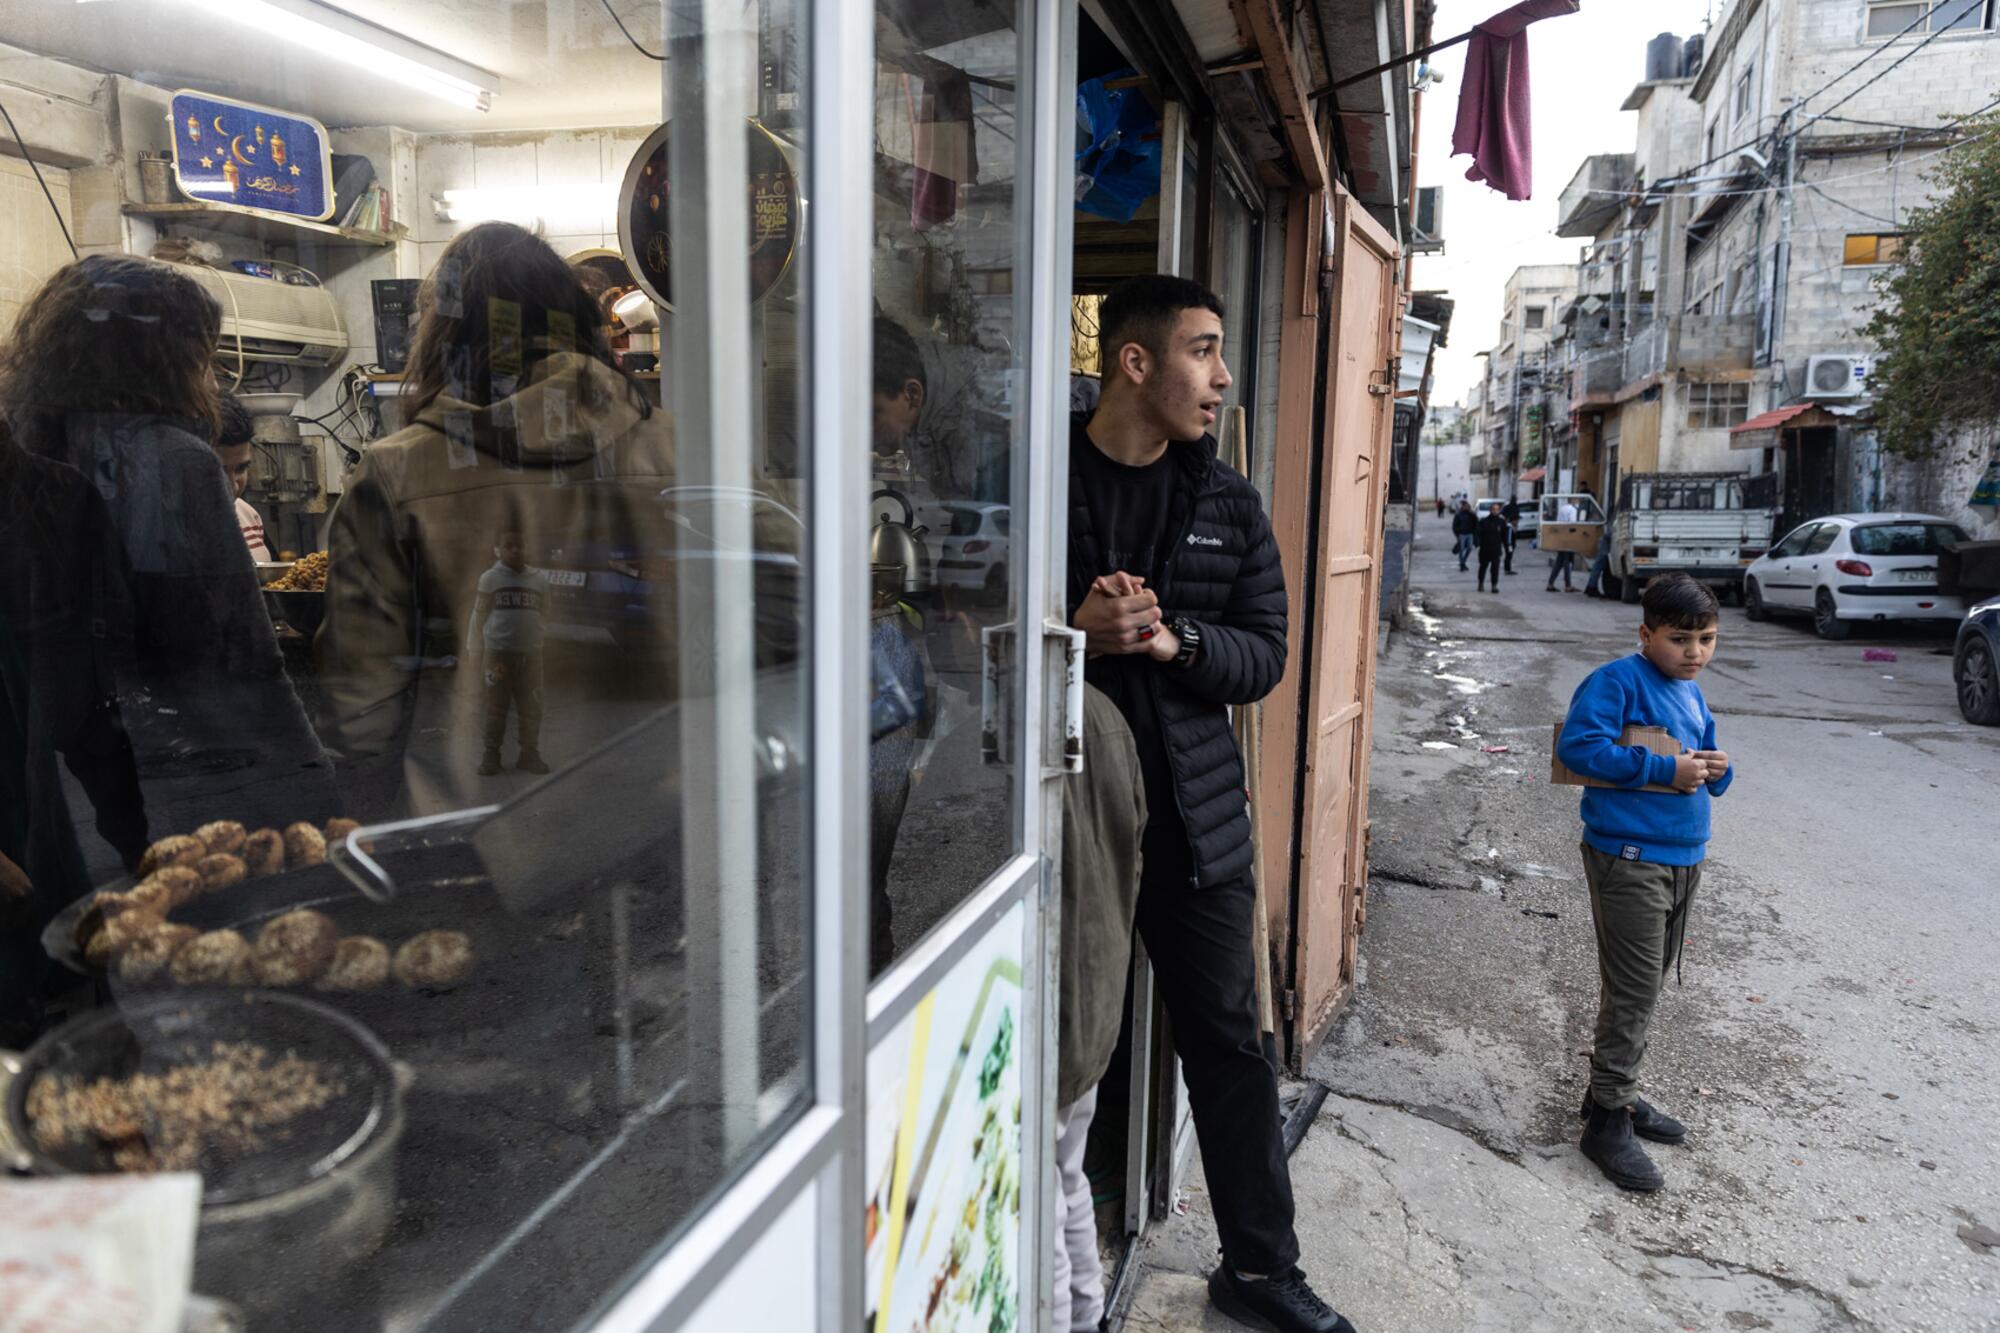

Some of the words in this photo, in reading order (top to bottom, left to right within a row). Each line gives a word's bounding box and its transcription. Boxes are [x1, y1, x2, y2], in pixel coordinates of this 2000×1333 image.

[756, 198, 788, 214] رمضان
[755, 213, 788, 230] كريم
[1196, 535, 1223, 546] Columbia
